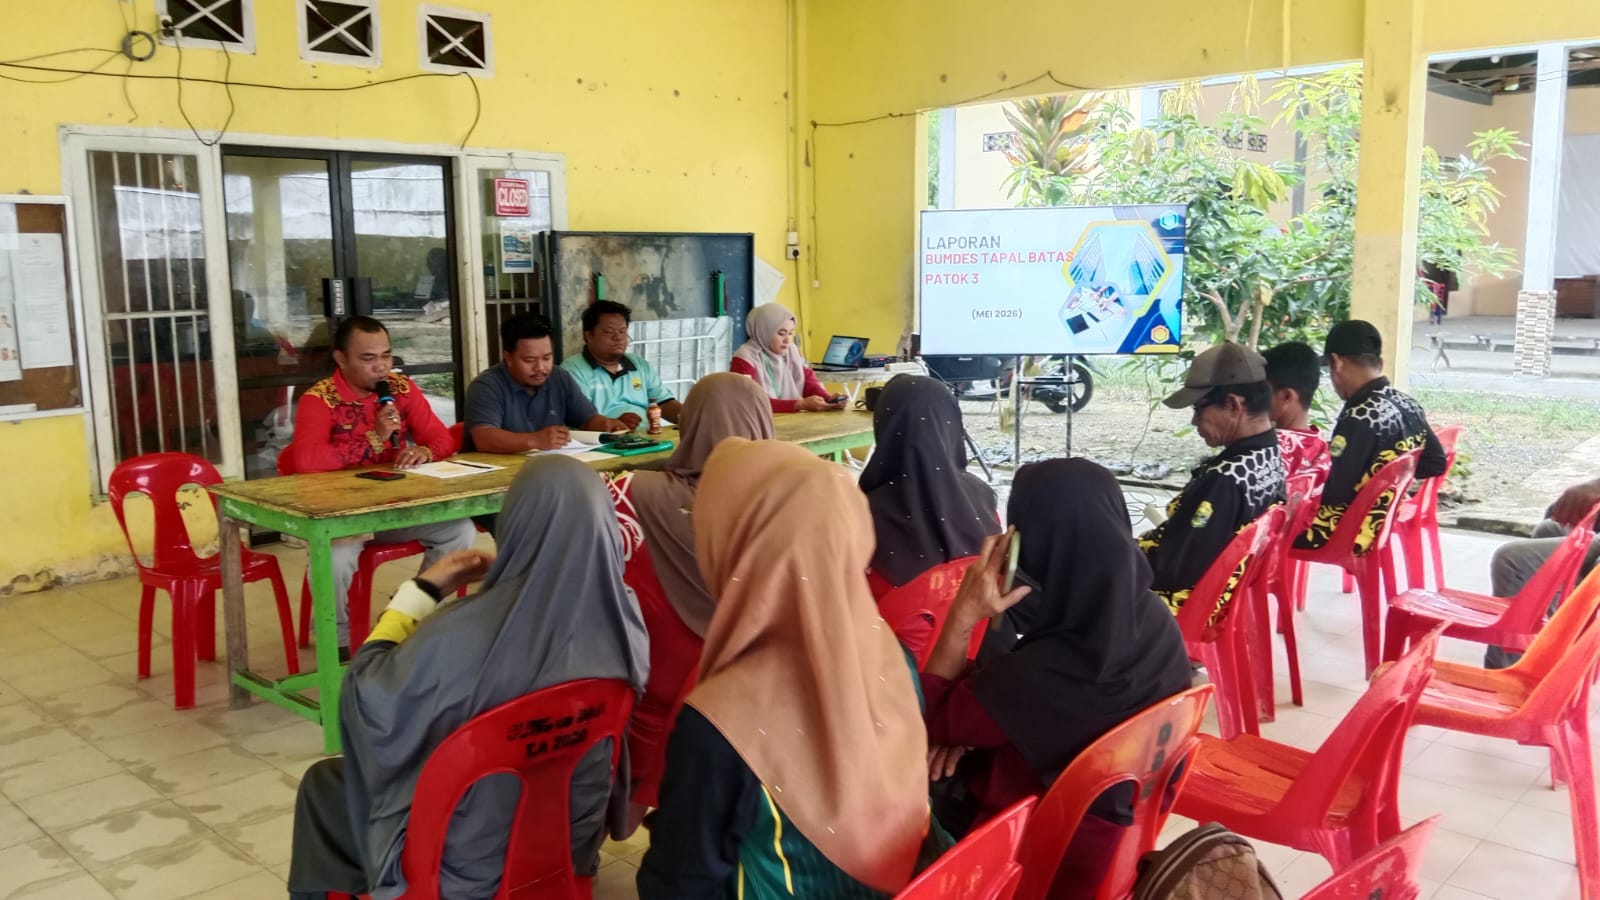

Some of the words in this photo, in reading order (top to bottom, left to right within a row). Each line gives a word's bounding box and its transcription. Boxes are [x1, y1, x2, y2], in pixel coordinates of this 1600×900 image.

[498, 188, 528, 207] CLOSED
[927, 235, 1001, 249] LAPORAN
[925, 253, 978, 265] BUMDES
[981, 252, 1025, 264] TAPAL
[1028, 251, 1074, 263] BATAS
[925, 273, 969, 284] PATOK
[971, 273, 979, 284] 3
[971, 308, 993, 320] (MEI
[995, 308, 1023, 319] 2026)
